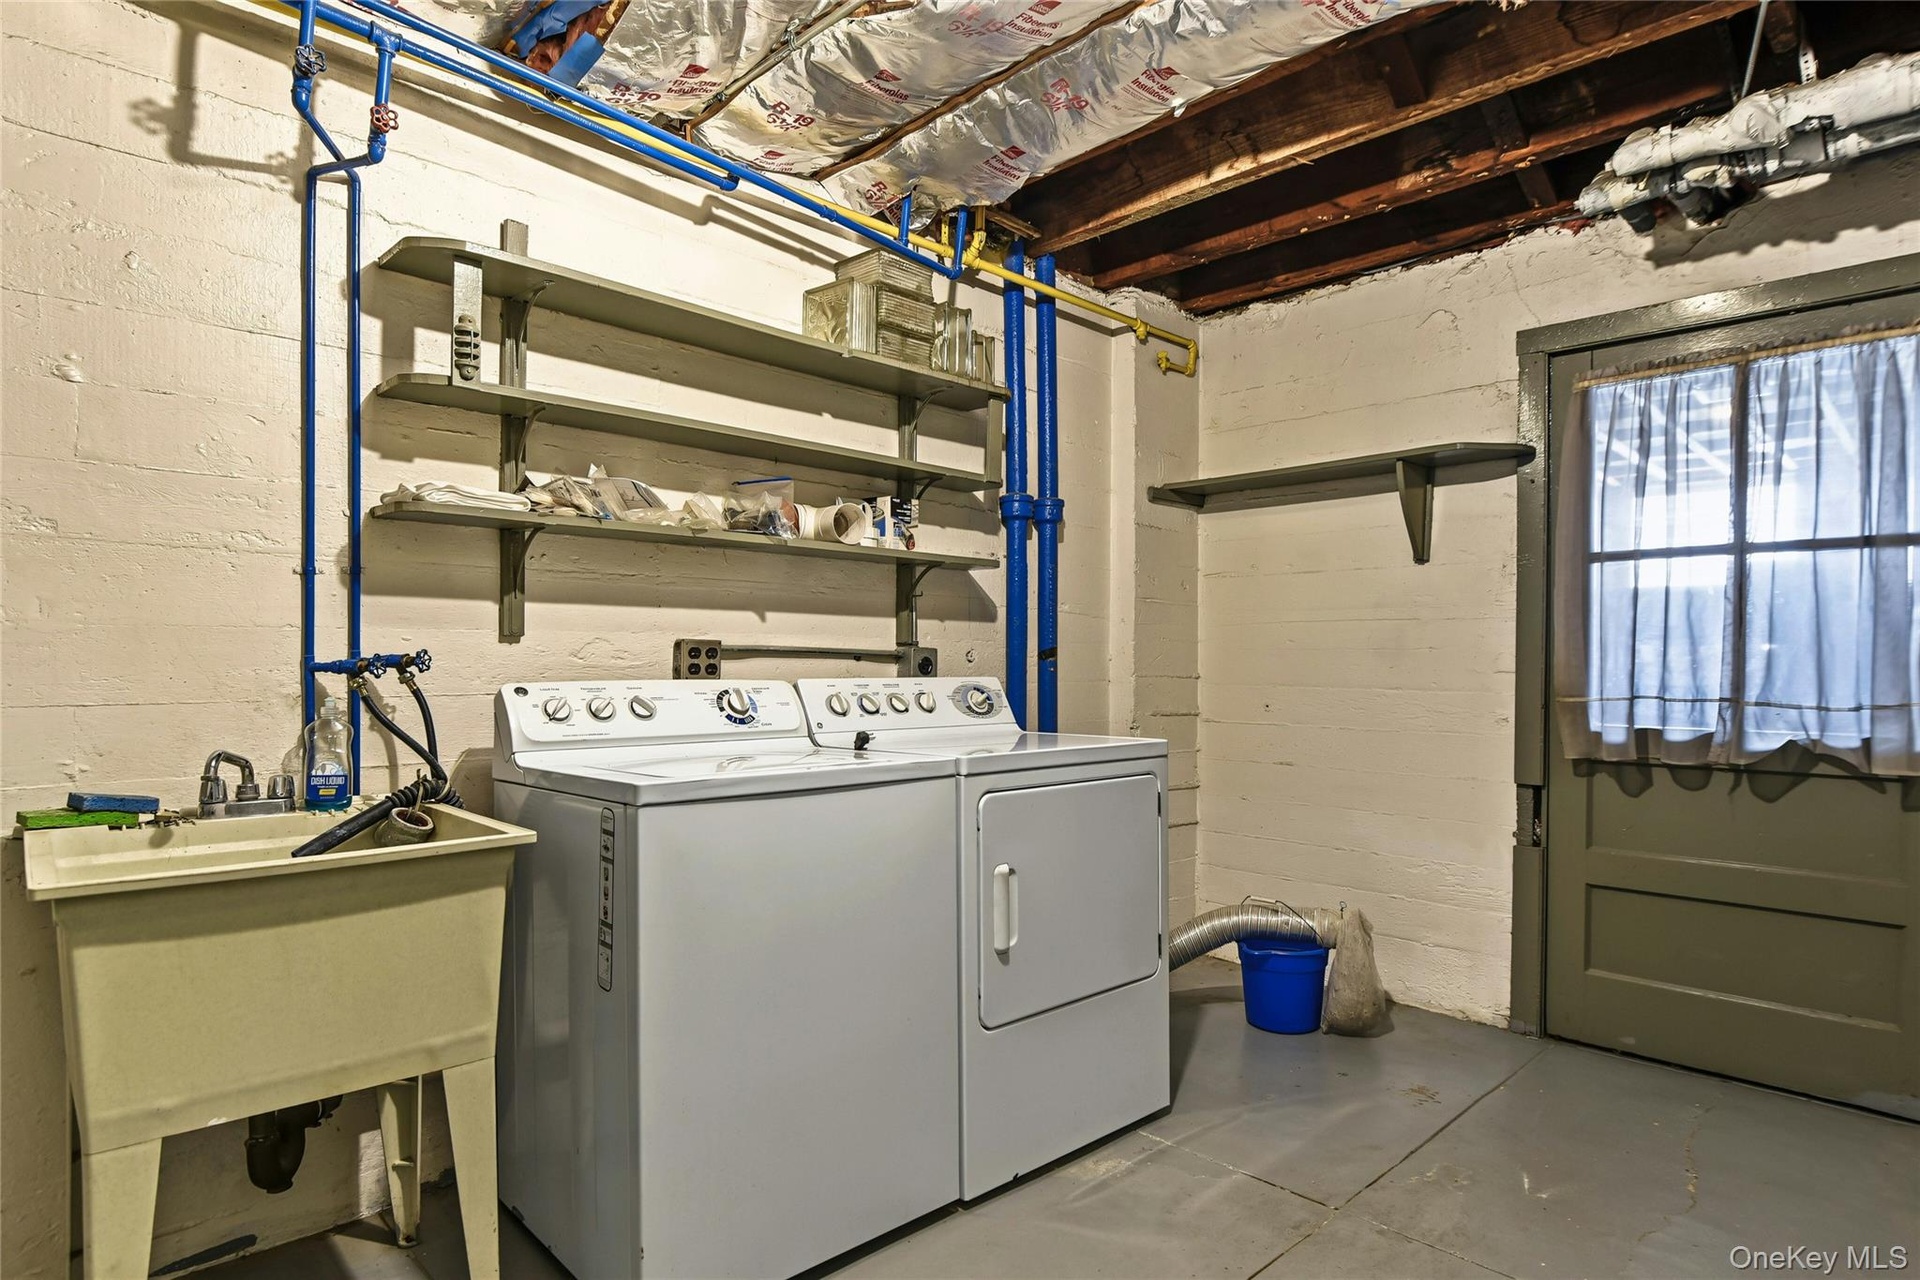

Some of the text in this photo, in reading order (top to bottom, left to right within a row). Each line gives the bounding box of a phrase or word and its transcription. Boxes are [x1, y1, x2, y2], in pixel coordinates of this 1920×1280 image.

[1005, 19, 1053, 38] Insulation
[865, 79, 910, 101] Fiberglas
[1131, 77, 1169, 103] Insulation
[310, 777, 325, 785] DISH
